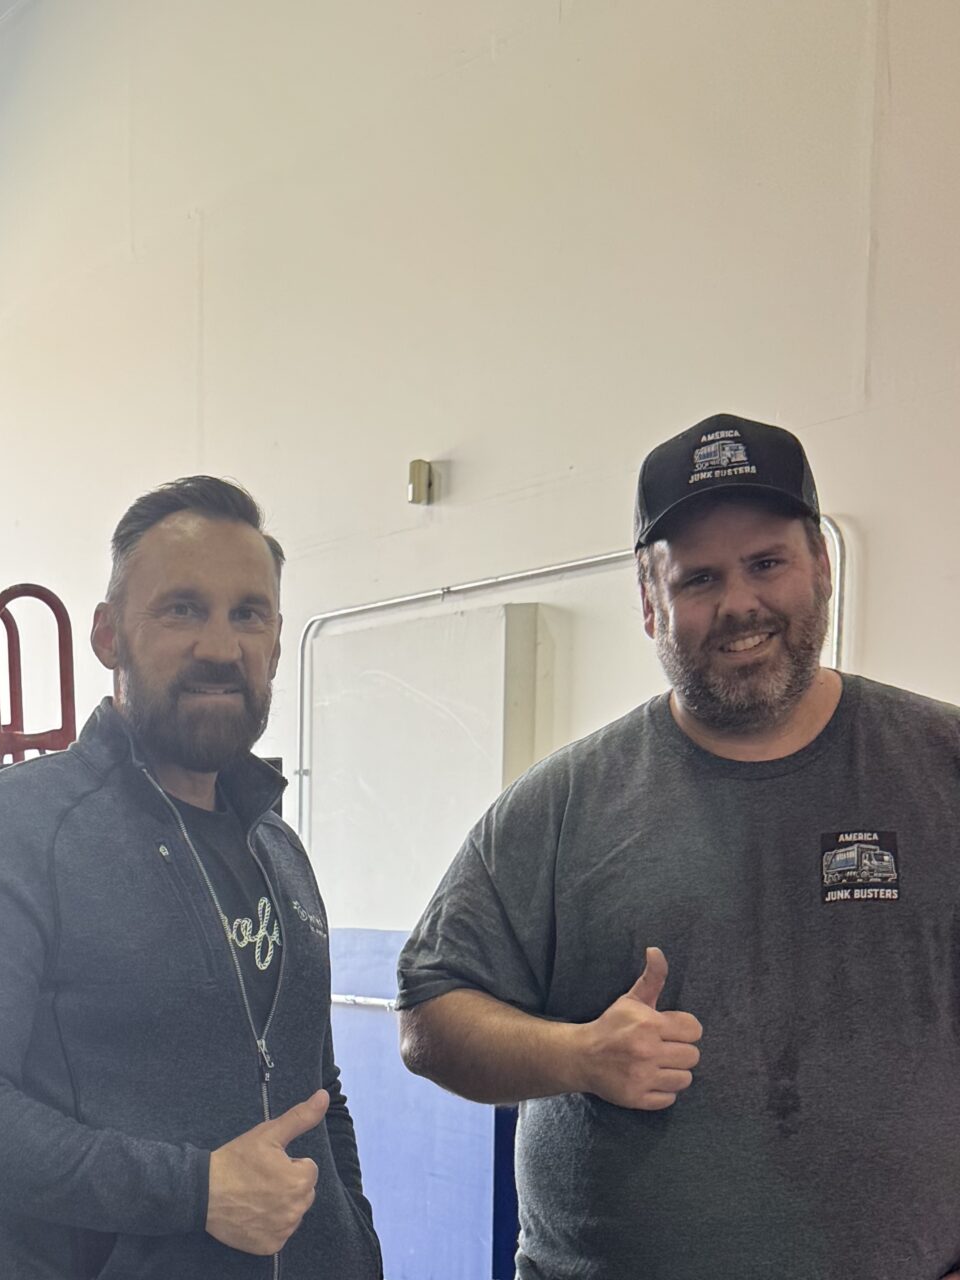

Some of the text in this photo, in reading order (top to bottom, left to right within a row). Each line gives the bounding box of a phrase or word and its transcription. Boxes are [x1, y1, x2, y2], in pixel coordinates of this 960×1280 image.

[700, 430, 741, 442] AMERICA
[688, 465, 756, 483] JUNK BUSTERS
[838, 832, 879, 842] AMERICA
[825, 888, 899, 901] JUNK BUSTERS
